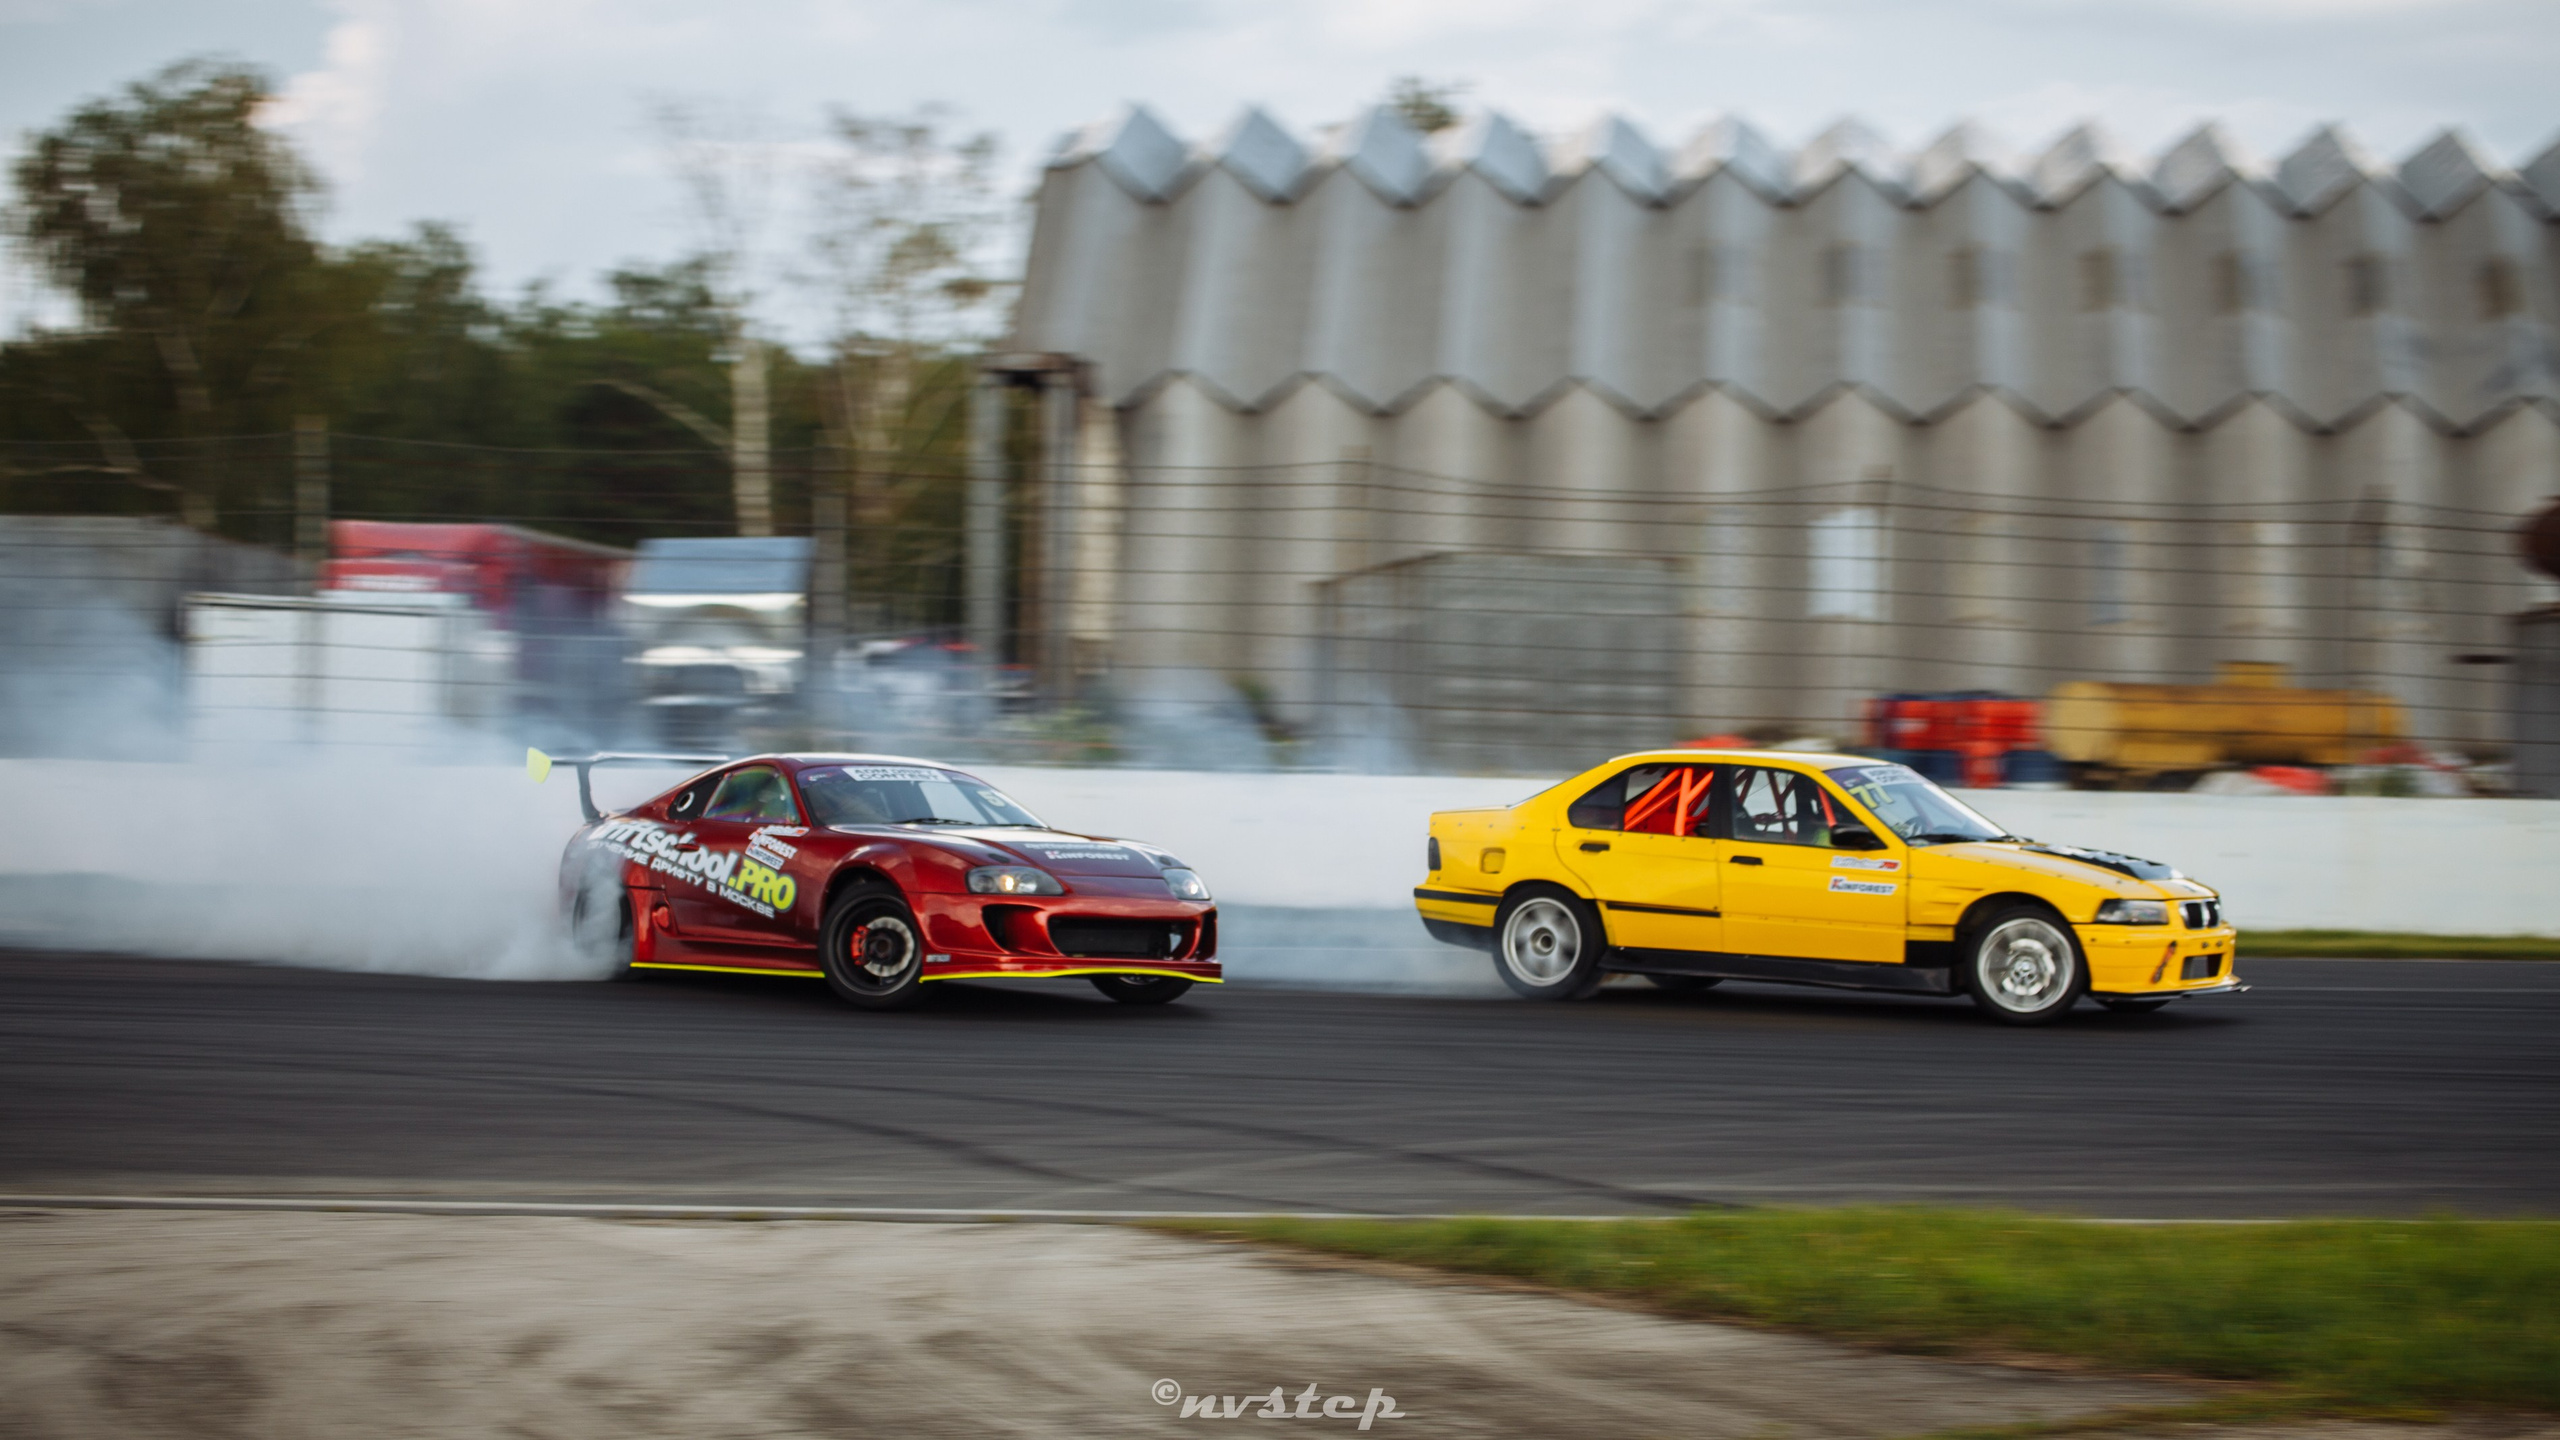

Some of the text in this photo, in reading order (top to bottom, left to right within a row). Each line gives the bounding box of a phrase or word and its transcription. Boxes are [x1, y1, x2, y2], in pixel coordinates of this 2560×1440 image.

[1847, 782, 1895, 809] 77
[587, 840, 775, 919] УЧЕНИЕ ДРИФТУ В МОСКВЕ
